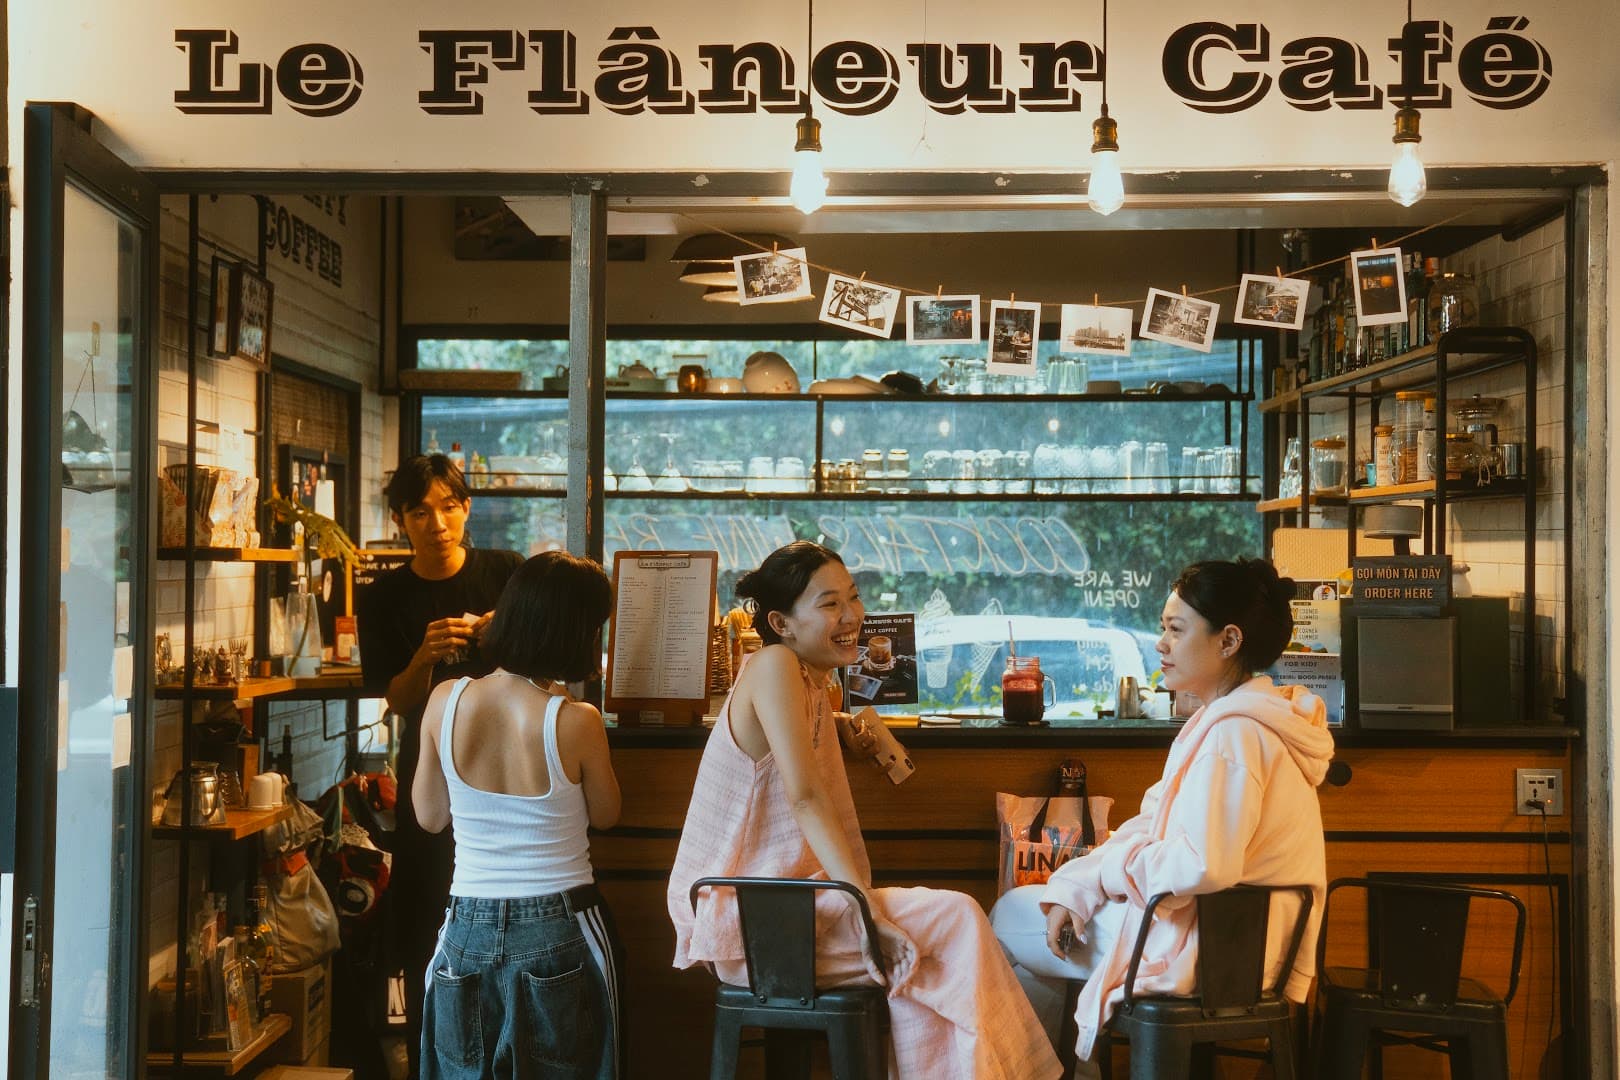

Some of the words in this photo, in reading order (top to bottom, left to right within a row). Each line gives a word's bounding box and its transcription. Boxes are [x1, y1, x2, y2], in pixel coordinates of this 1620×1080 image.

[174, 29, 364, 118] Le
[418, 26, 1104, 116] Flâneur
[1162, 15, 1554, 116] Café
[265, 197, 343, 288] COFFEE
[1357, 567, 1374, 581] GỌI
[1403, 567, 1418, 581] TẠI
[1364, 587, 1401, 599] ORDER
[1404, 587, 1433, 599] HERE
